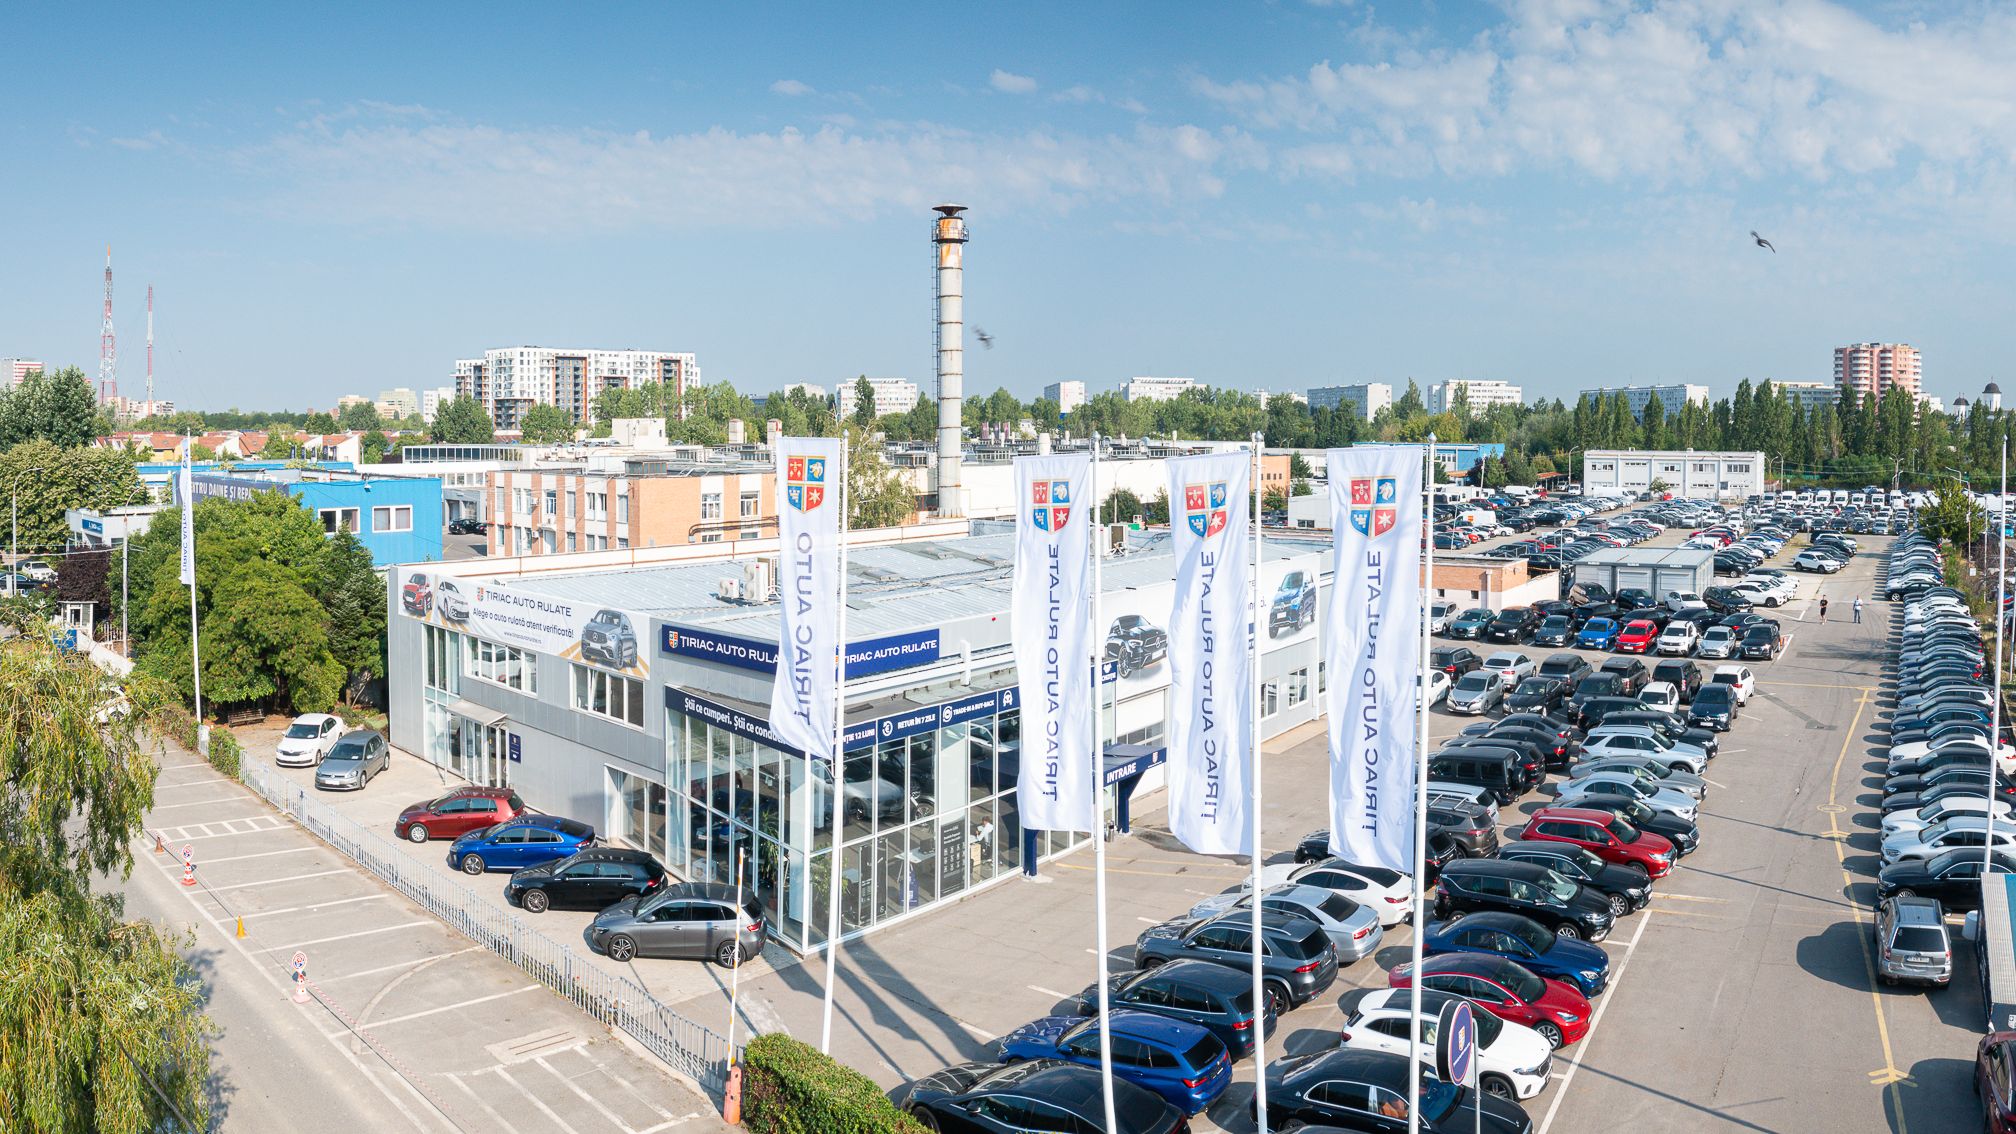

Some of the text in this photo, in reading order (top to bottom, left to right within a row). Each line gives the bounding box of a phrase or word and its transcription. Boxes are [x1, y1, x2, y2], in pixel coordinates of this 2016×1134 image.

[513, 597, 536, 609] AUTO
[537, 601, 572, 617] RULATE
[473, 607, 488, 619] Alege
[494, 613, 507, 623] auto
[526, 620, 542, 631] atent
[716, 642, 746, 657] AUTO
[748, 648, 779, 664] RULA
[874, 646, 900, 660] AUTO
[901, 639, 938, 655] RULATE
[696, 703, 703, 714] ce
[703, 706, 732, 725] cumperi.
[746, 722, 755, 733] ce
[855, 731, 862, 740] 12
[1106, 762, 1136, 784] INTRARE
